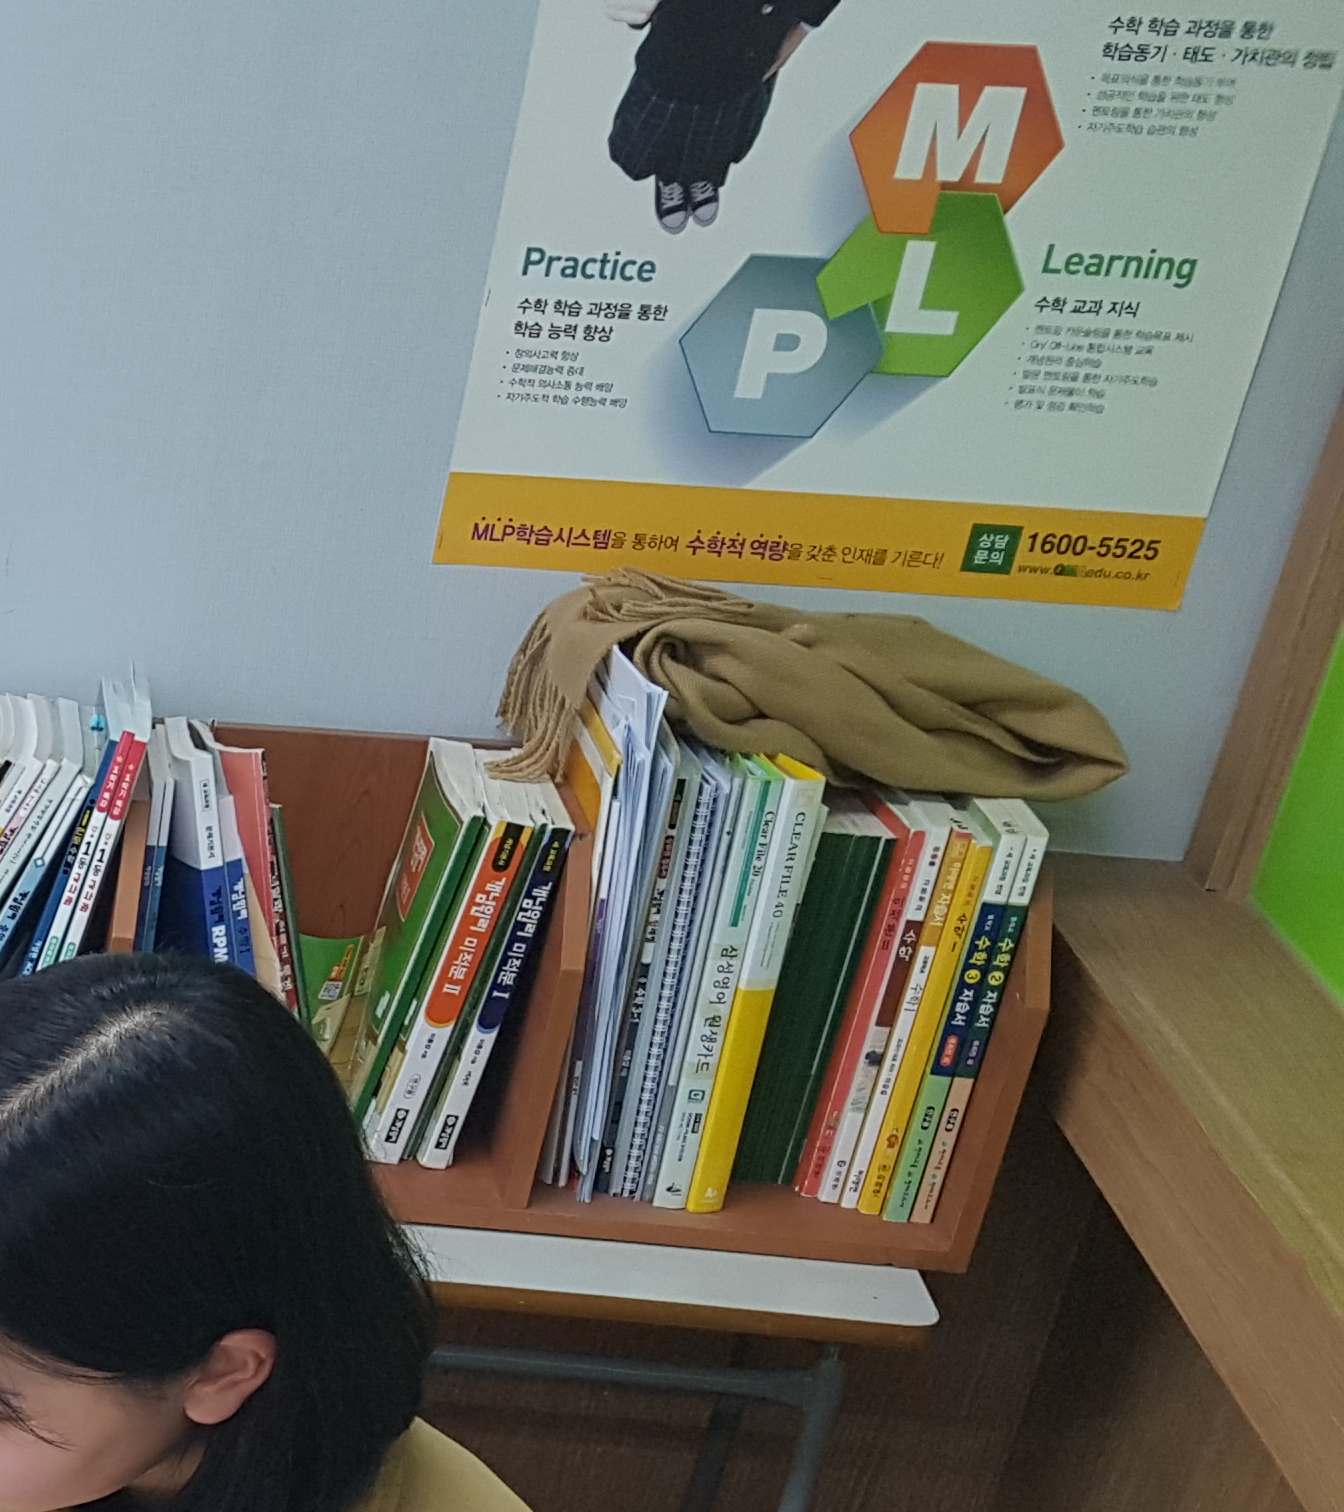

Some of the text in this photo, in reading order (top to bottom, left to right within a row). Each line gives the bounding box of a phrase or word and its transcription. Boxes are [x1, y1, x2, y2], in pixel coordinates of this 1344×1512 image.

[1108, 16, 1274, 40] 수학 학습 과정을 통한
[1102, 42, 1168, 62] 학습동기
[1182, 43, 1216, 63] 태도
[893, 82, 1027, 184] M
[522, 247, 656, 282] Practice
[1042, 244, 1198, 288] Learning
[517, 298, 668, 321] 수학 학습 과정을 통한
[884, 240, 960, 336] L
[1035, 296, 1140, 318] 수학 교과 지식
[514, 321, 613, 342] 학습 능력 향상
[732, 307, 827, 399] P
[471, 517, 944, 570] MLP학습시스템을 통하여 수학적 역량을 갖춘 인재를 기른다!
[973, 550, 1004, 566] 문의
[978, 532, 1010, 549] 상담
[1027, 532, 1162, 561] 1600-5525
[747, 809, 778, 878] Clear File 20
[768, 809, 811, 920] CLEAR FILE 40
[204, 825, 227, 963] 문제기본서 RPM
[464, 870, 507, 935] 개념원리
[511, 875, 552, 941] 개념원리
[928, 891, 952, 928] 자습서
[447, 934, 478, 982] 미적분
[495, 939, 525, 988] 미적분
[967, 933, 993, 968] 수학
[990, 934, 1017, 969] 수학
[702, 941, 744, 1008] 삼성영어
[948, 985, 975, 1029] 자습서
[973, 988, 1000, 1030] 자습서
